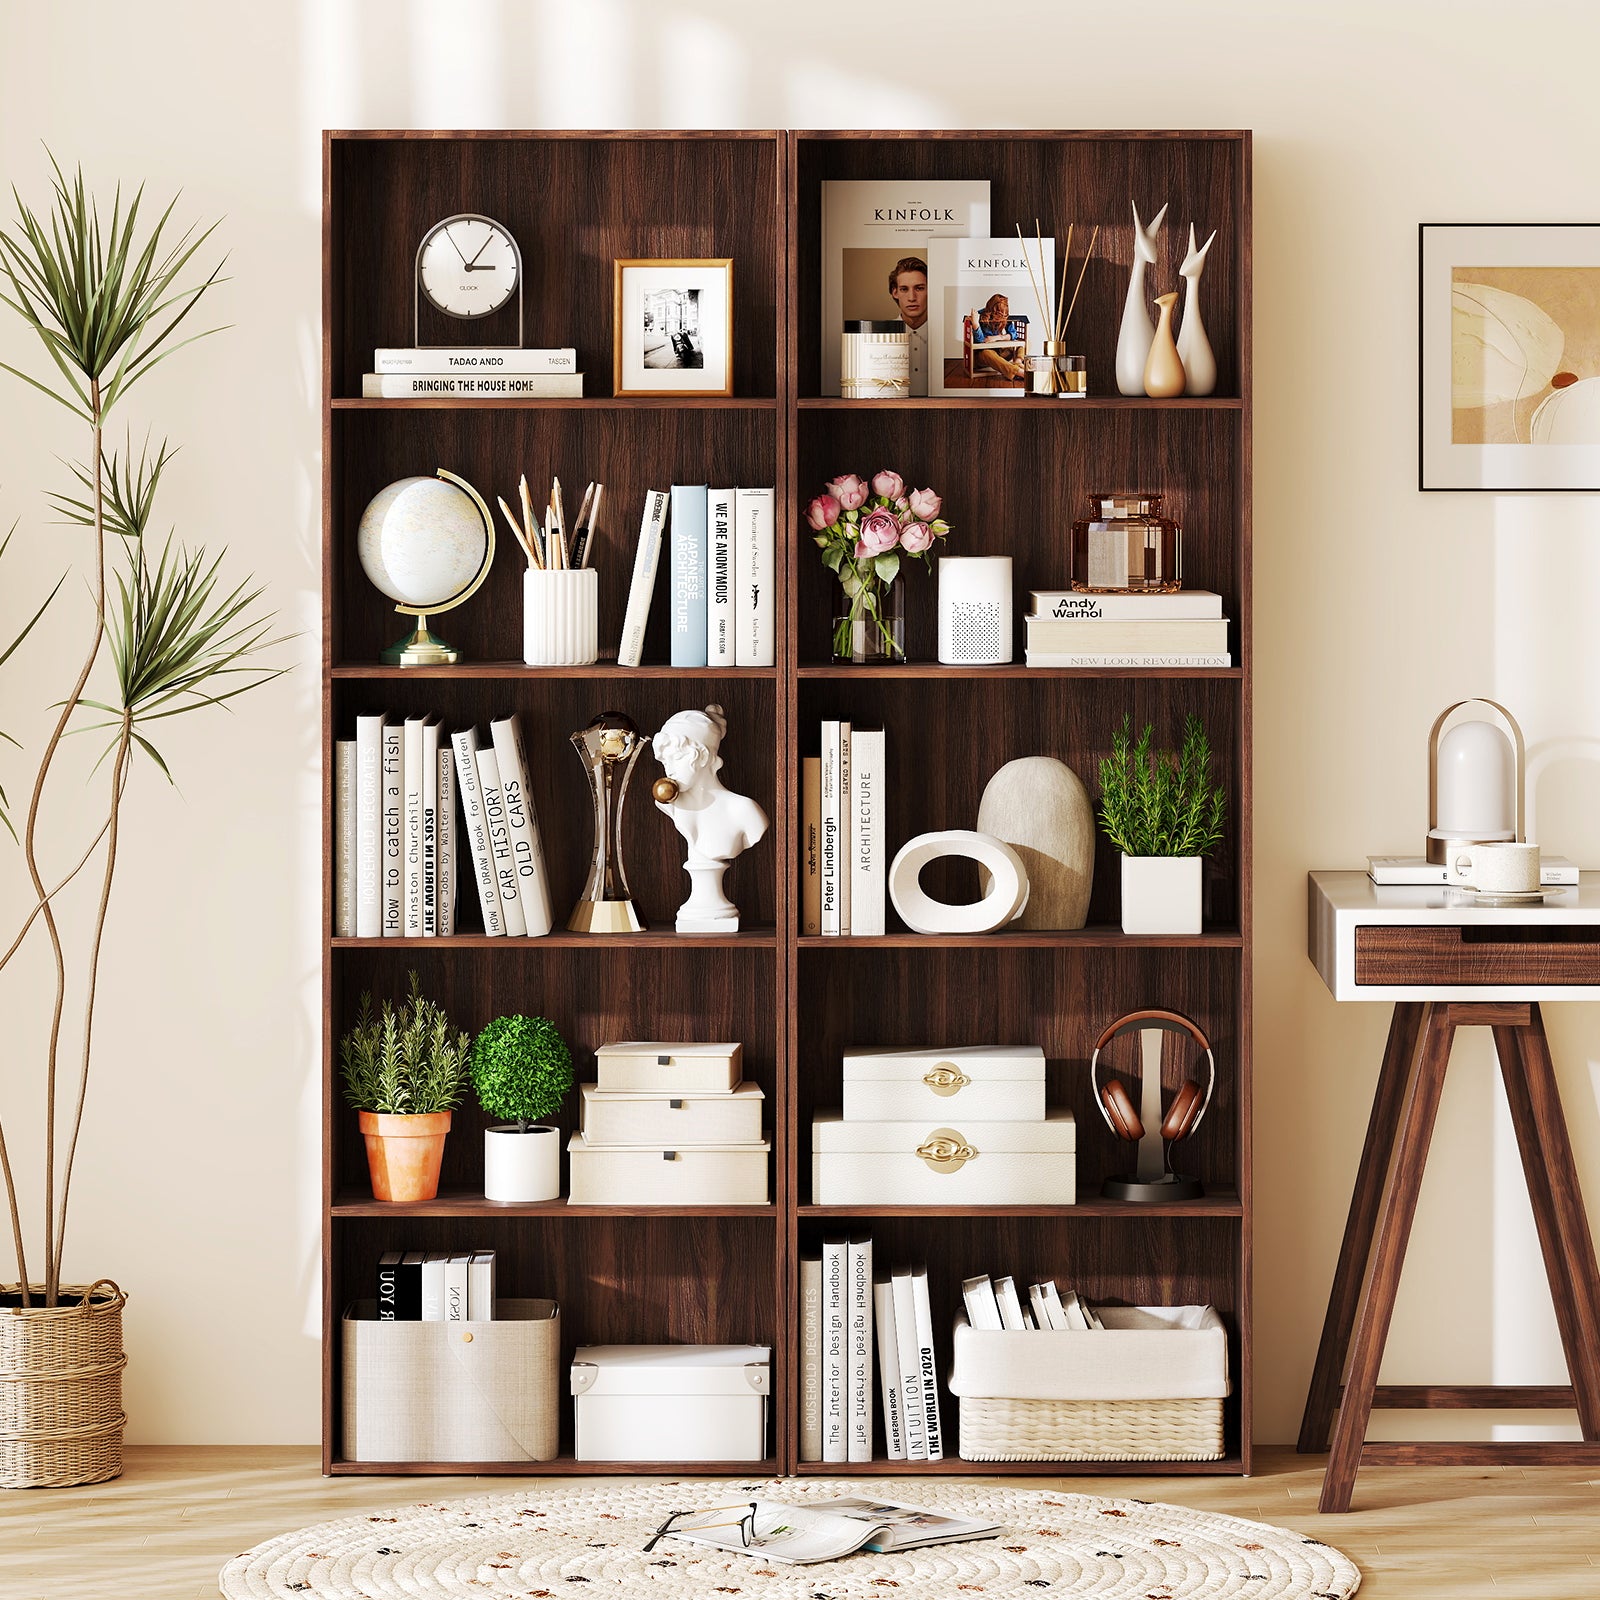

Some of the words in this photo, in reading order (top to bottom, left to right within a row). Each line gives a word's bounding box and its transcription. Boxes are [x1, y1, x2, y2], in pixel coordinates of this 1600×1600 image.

[874, 208, 954, 221] KINFOLK
[968, 258, 1028, 268] KINFOLK
[449, 357, 478, 366] TADAO
[479, 357, 504, 366] ANDO
[412, 380, 455, 392] BRINGING
[457, 380, 475, 392] THE
[477, 380, 506, 392] HOUSE
[508, 380, 534, 392] HOME
[715, 502, 728, 518] WE
[715, 520, 728, 540] ARE
[751, 509, 760, 542] Dreaming
[751, 543, 760, 551] of
[687, 534, 698, 600] JAPANESE
[715, 542, 728, 604] ANONYMOUS
[751, 551, 760, 577] Sweden
[677, 534, 688, 633] ARCHITECTURE
[1052, 608, 1103, 618] Warhol
[1058, 598, 1097, 610] Andy
[1070, 657, 1100, 665] NEW
[1103, 657, 1139, 665] LOOK
[1143, 657, 1226, 665] REVOLUTION
[342, 745, 350, 770] house
[384, 735, 400, 775] fish
[459, 737, 475, 791] children
[342, 773, 350, 788] the
[363, 746, 376, 822] DECORATES
[440, 750, 449, 801] Isaacson
[342, 793, 350, 802] in
[388, 786, 400, 796] a
[504, 780, 525, 828] CARS
[470, 798, 480, 817] for
[484, 786, 510, 859] HISTORY
[861, 772, 871, 872] ARCHITECTURE
[384, 807, 400, 858] catch
[409, 791, 419, 864] Churchill
[440, 807, 449, 846] Walter
[473, 824, 486, 852] Book
[440, 851, 451, 864] by
[515, 841, 534, 877] OLD
[824, 817, 837, 877] Lindbergh
[343, 864, 350, 874] an
[363, 830, 376, 905] HOUSEHOLD
[386, 868, 400, 888] to
[440, 870, 449, 895] Jobs
[478, 857, 493, 885] DRAW
[484, 891, 495, 905] TO
[499, 868, 517, 900] CAR
[824, 880, 834, 911] Peter
[342, 902, 350, 911] to
[385, 898, 400, 929] How
[409, 872, 419, 929] Winston
[440, 901, 449, 933] Steve
[488, 911, 500, 932] HOW
[829, 1253, 840, 1308] Handbook
[805, 1288, 817, 1356] DECORATES
[829, 1315, 843, 1356] Design
[920, 1347, 933, 1377] 2020
[805, 1363, 817, 1431] HOUSEHOLD
[829, 1363, 840, 1417] Interior
[923, 1379, 935, 1391] IN
[905, 1375, 924, 1455] INTUITION
[924, 1392, 938, 1433] WORLD
[829, 1424, 840, 1445] The
[928, 1434, 940, 1455] THE
